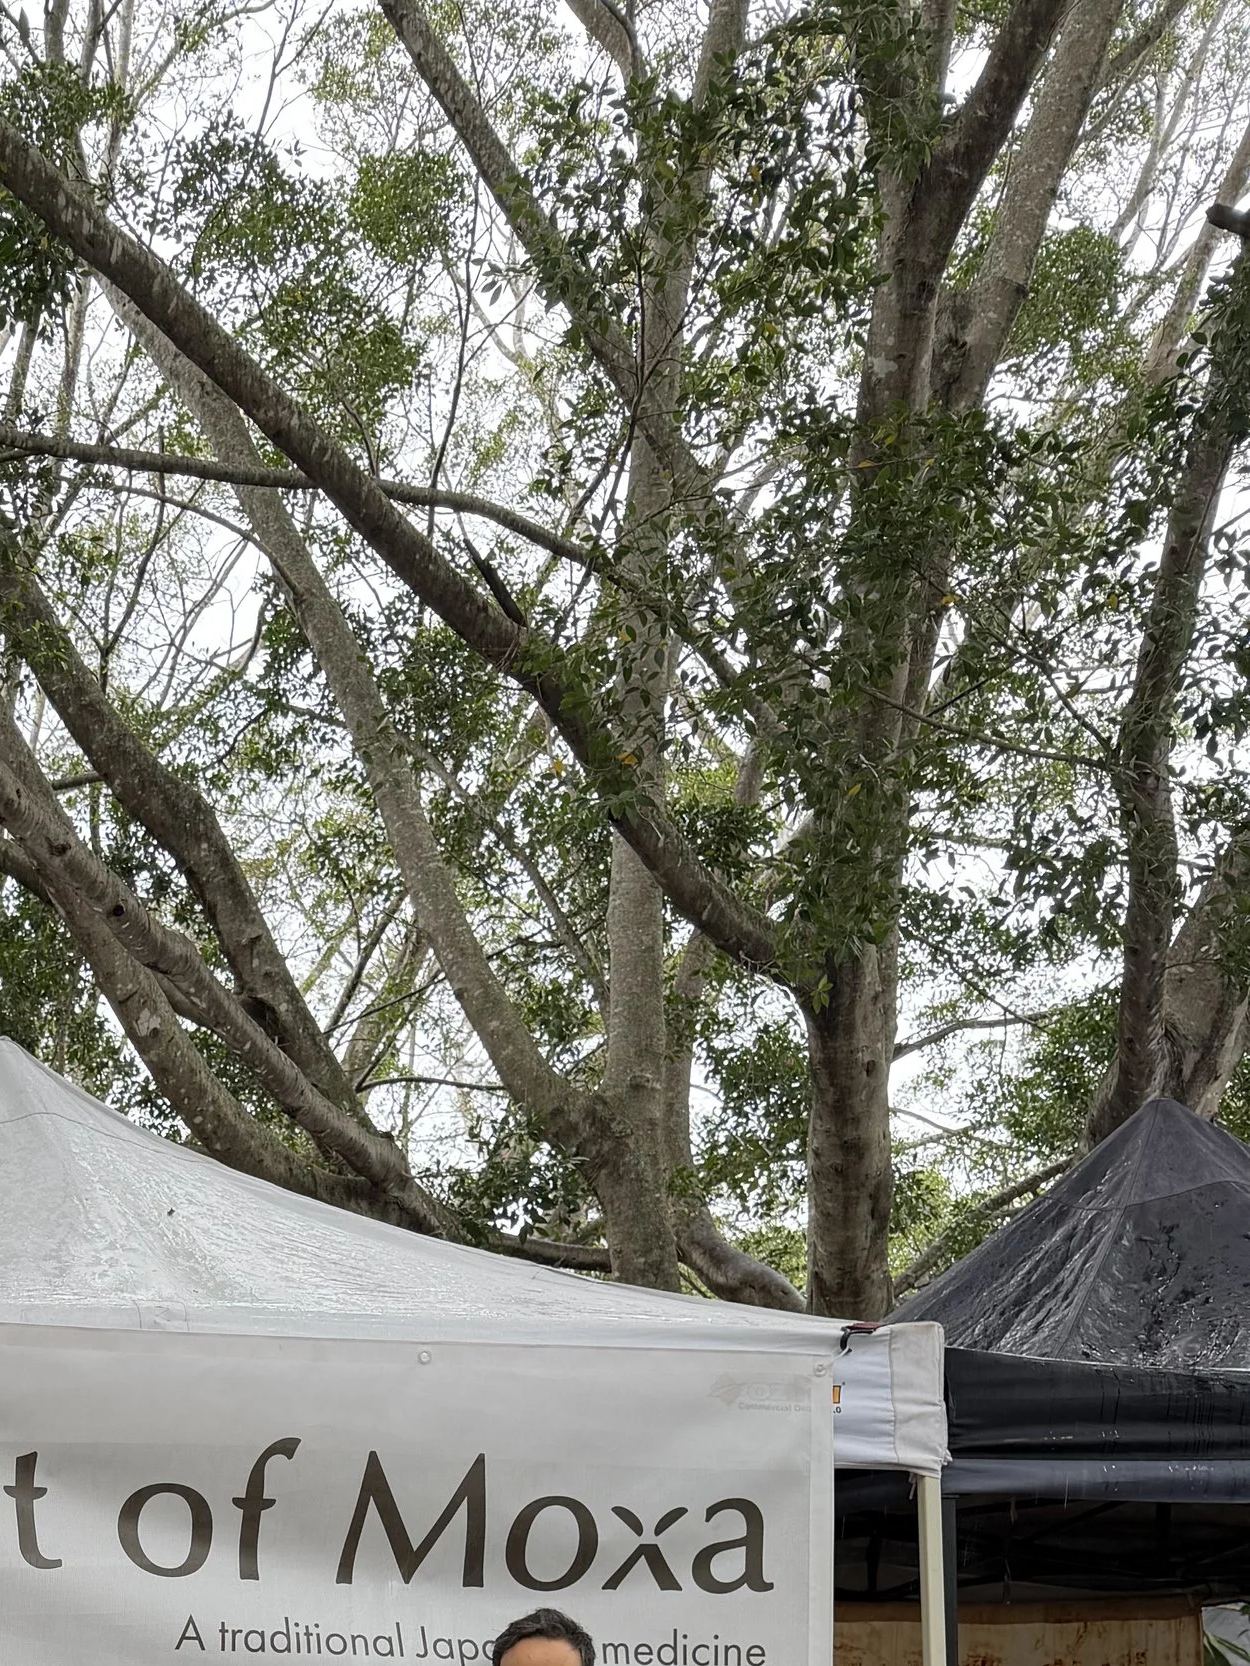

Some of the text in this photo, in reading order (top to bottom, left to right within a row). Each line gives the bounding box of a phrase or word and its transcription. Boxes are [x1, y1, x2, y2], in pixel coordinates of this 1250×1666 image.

[117, 1437, 302, 1581] of
[336, 1450, 775, 1595] Moxa
[174, 1614, 206, 1651] A
[218, 1616, 405, 1657] traditional
